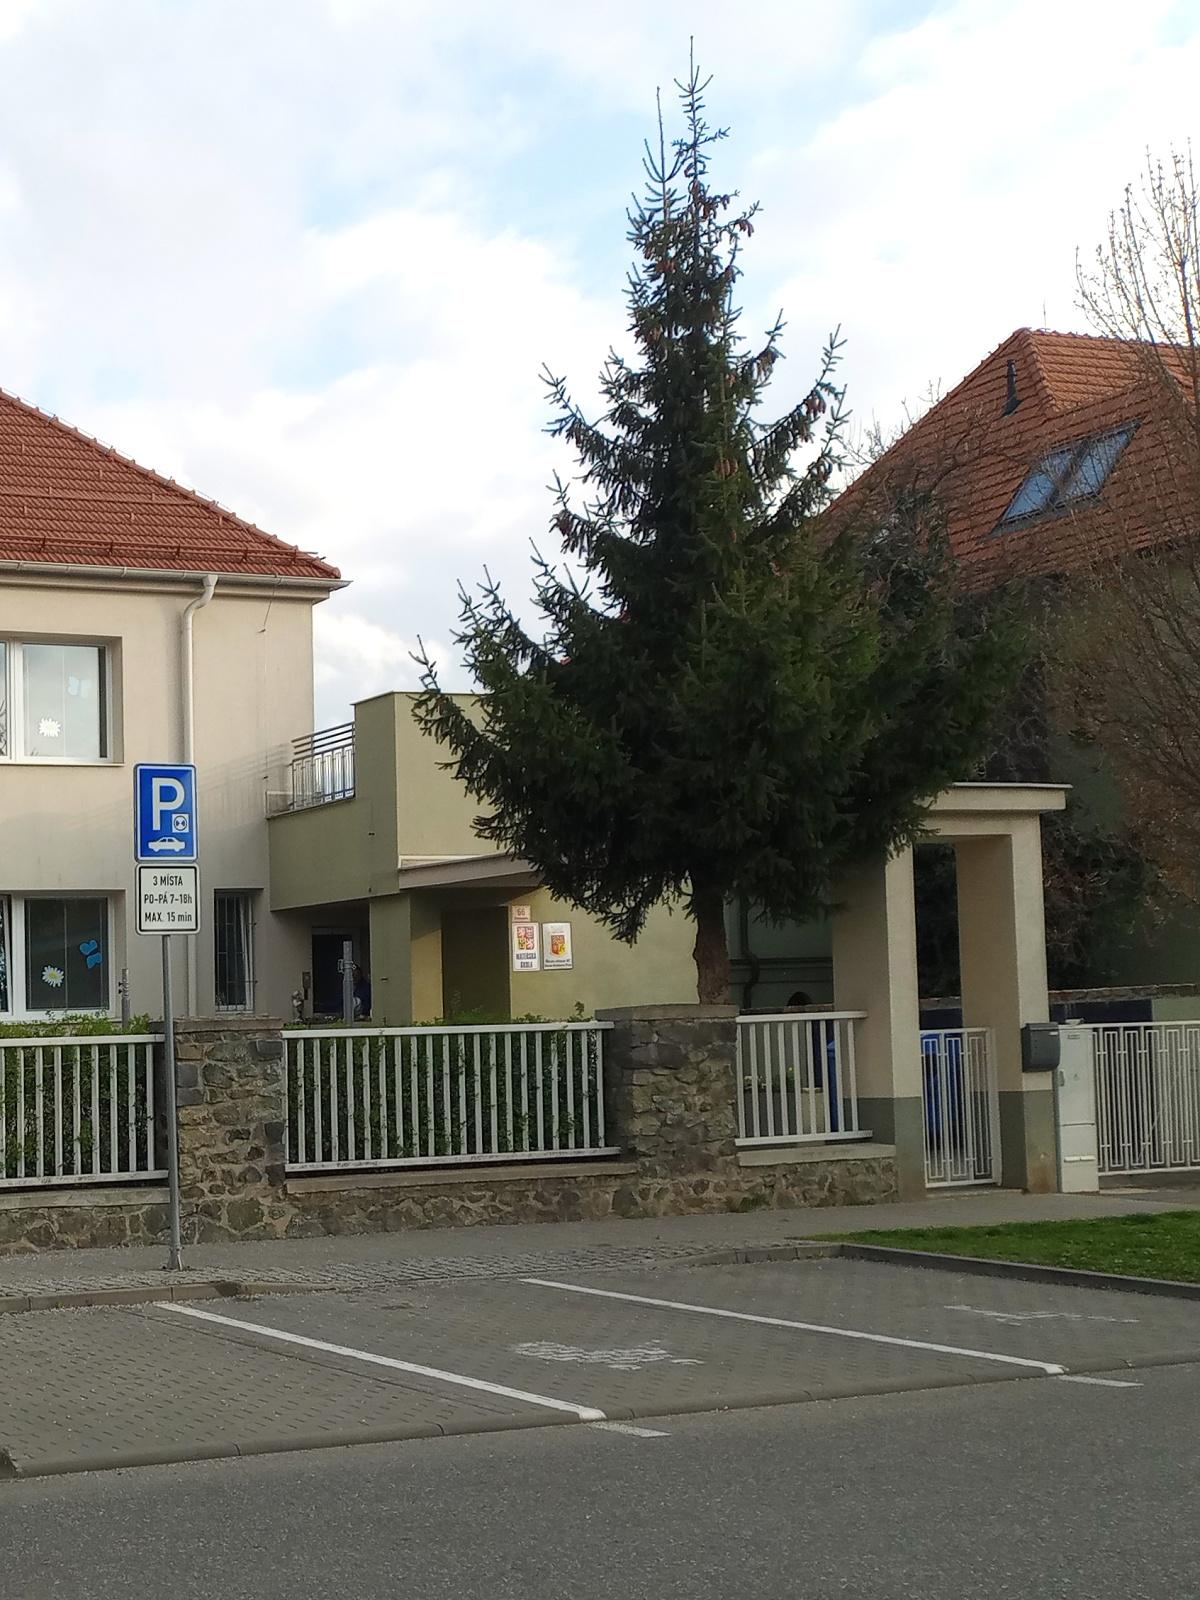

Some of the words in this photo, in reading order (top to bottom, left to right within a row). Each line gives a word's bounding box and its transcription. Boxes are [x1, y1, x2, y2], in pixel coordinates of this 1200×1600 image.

[152, 777, 185, 830] P
[153, 876, 158, 886] 3
[160, 873, 183, 886] MÍSTA
[144, 891, 168, 904] PO-PÁ
[170, 894, 192, 904] 7-18h
[167, 912, 175, 922] 15
[177, 912, 192, 922] min
